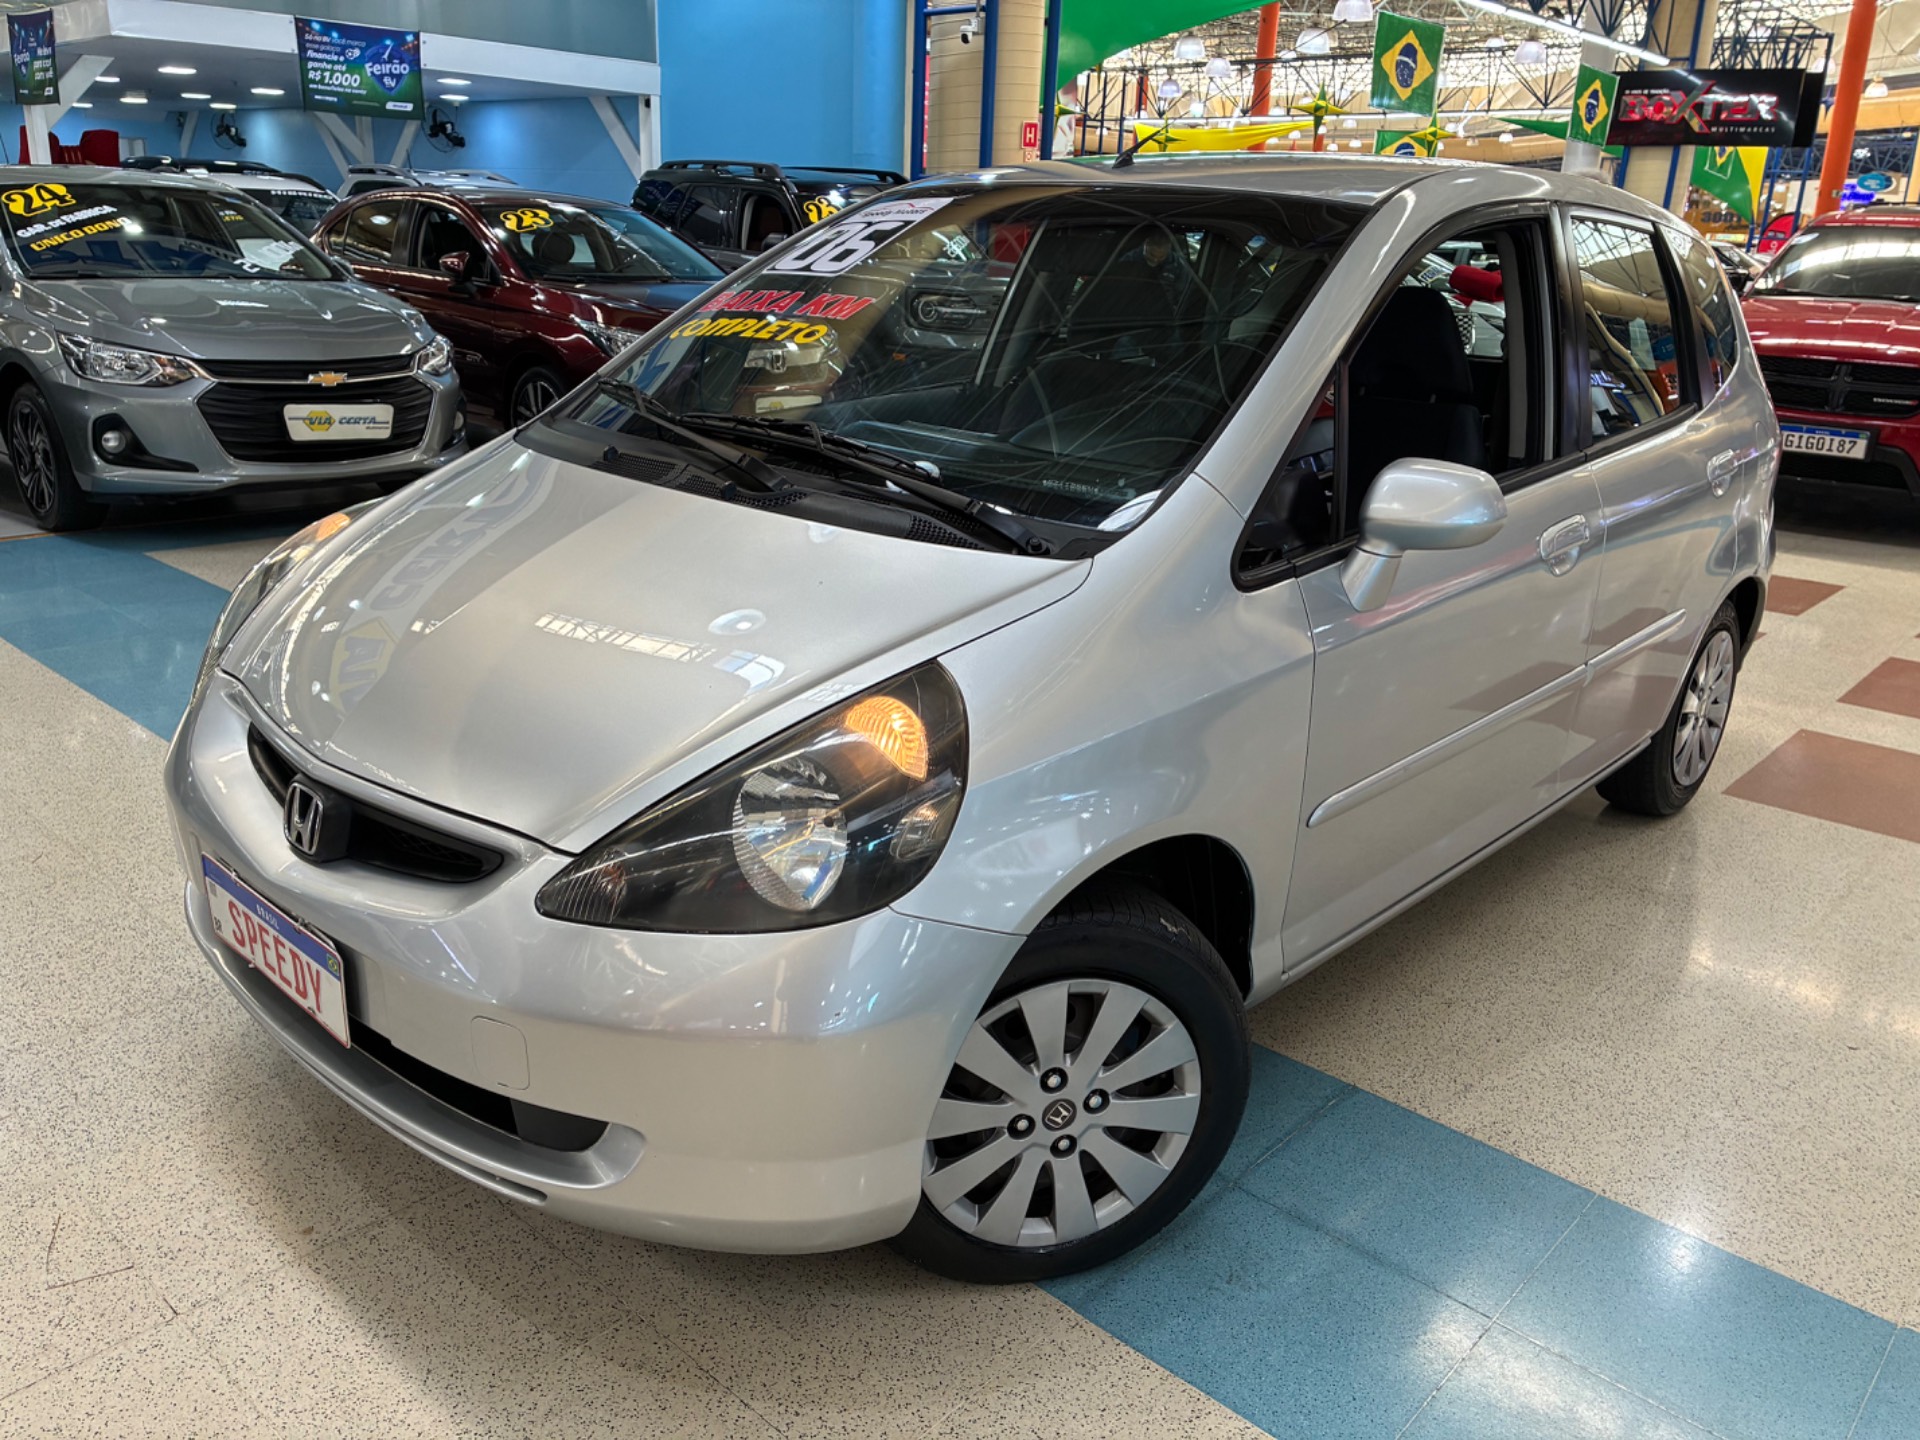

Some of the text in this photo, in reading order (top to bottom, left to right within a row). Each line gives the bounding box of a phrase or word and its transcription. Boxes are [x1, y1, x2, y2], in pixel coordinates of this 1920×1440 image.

[306, 49, 339, 61] financie
[307, 61, 347, 72] ganhe até
[365, 60, 410, 77] Feirão
[1026, 127, 1035, 143] H
[1711, 125, 1776, 133] MULTIMARCAS
[3, 184, 75, 216] 24
[501, 208, 553, 232] 23
[30, 217, 132, 252] UNICO DONO
[774, 221, 906, 272] 06
[698, 289, 877, 320] BAIXA KM
[668, 317, 829, 344] COMPLETO
[308, 416, 376, 425] VIA CERTA
[256, 903, 279, 930] BRASIL
[228, 899, 321, 1014] SPEEDY
